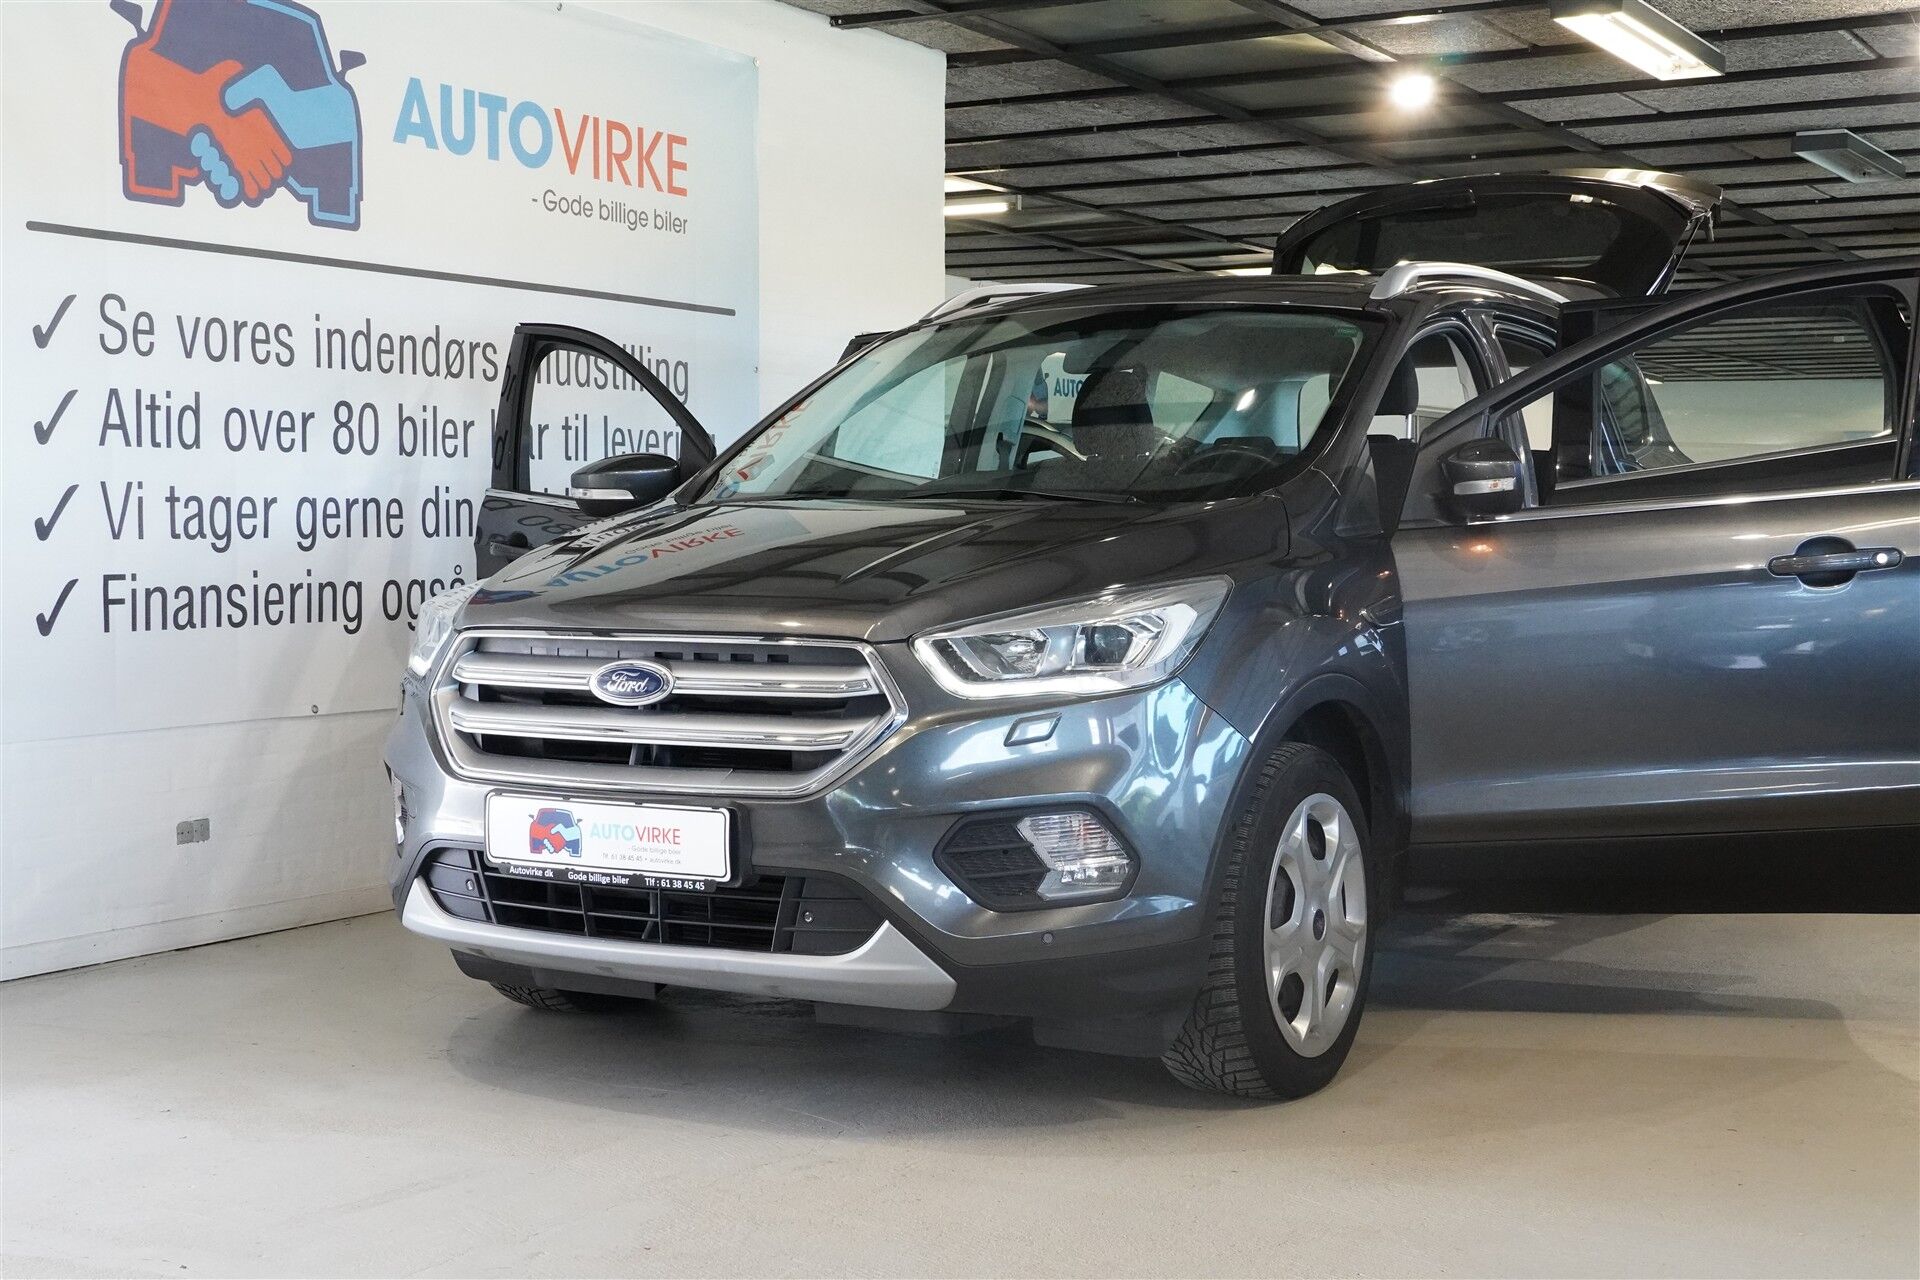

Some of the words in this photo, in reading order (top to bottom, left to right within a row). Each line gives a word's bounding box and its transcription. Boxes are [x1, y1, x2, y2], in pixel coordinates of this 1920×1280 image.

[393, 77, 687, 197] AUTOVIRKE
[543, 189, 593, 218] Gode
[599, 198, 648, 231] billige
[654, 209, 687, 234] biler
[99, 293, 155, 356] Se
[176, 315, 295, 367] vores
[314, 313, 499, 382] indendørs
[99, 387, 201, 450] Altid
[224, 407, 315, 453] over
[333, 400, 379, 456] 80
[398, 402, 475, 459] biler
[561, 414, 588, 462] til
[100, 481, 144, 540] Vi
[165, 485, 278, 553] tager
[296, 496, 404, 552] gerne
[421, 485, 474, 539] din
[102, 569, 363, 634] Finansiering
[604, 670, 649, 693] Ford
[590, 823, 680, 845] AUTOVIRKE
[509, 866, 542, 876] Autovirke
[544, 868, 554, 877] dk
[568, 871, 588, 881] Gode
[588, 873, 611, 885] billige
[612, 875, 630, 884] biler
[661, 879, 671, 888] 61
[672, 880, 682, 888] 38
[684, 881, 694, 889] 45
[695, 881, 705, 890] 45
